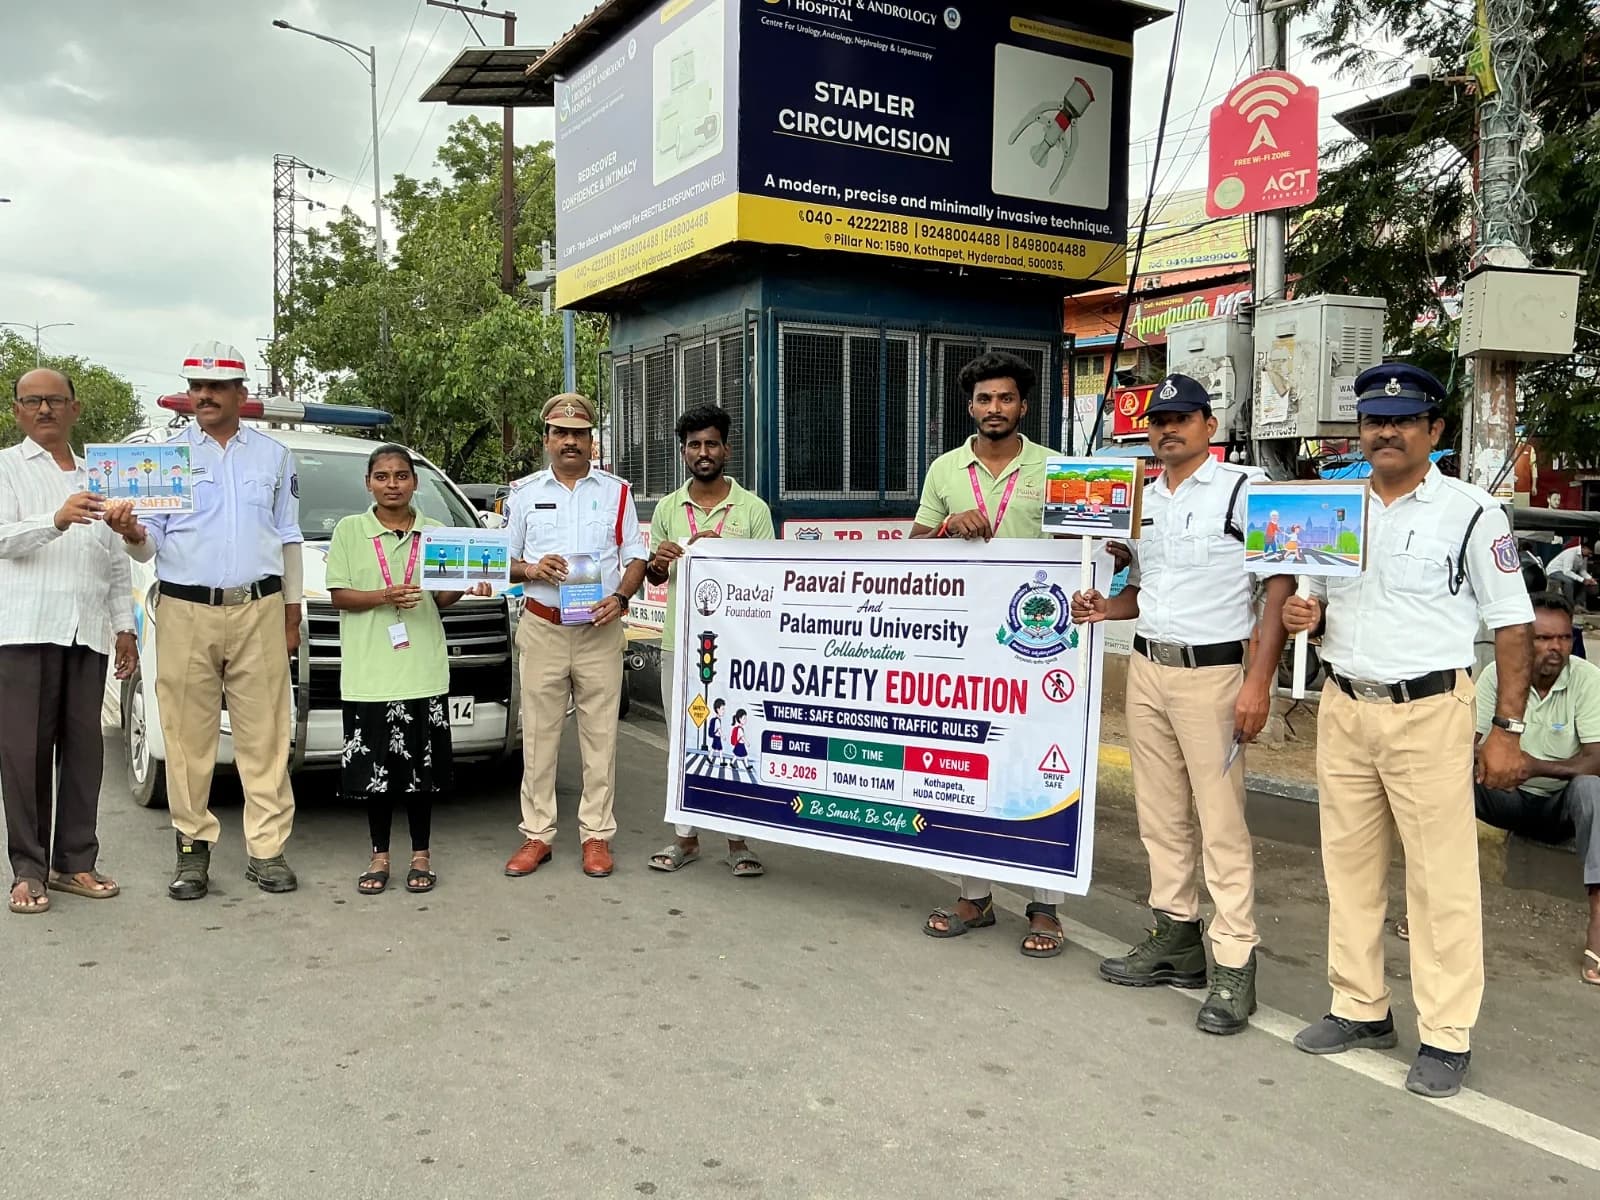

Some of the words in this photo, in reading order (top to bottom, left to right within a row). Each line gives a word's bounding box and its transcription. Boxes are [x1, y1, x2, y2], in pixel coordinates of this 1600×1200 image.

[796, 0, 853, 22] HOSPITAL
[867, 3, 938, 26] ANDROLOGY
[761, 16, 783, 29] Centre
[784, 21, 796, 31] For
[855, 36, 889, 52] Nephrology
[814, 81, 915, 119] STAPLER
[778, 109, 950, 157] CIRCUMCISION
[577, 151, 617, 184] REDISCOVER
[1234, 158, 1251, 167] FREE
[1271, 150, 1291, 160] ZONE
[562, 181, 599, 211] CONFIDENCE
[605, 158, 637, 187] INTIMACY
[1263, 169, 1311, 194] ACT
[640, 200, 667, 221] ERECTILE
[667, 178, 711, 208] DYSFUNCTION
[764, 174, 776, 188] A
[779, 177, 842, 199] modern,
[845, 187, 898, 208] precise
[901, 194, 927, 210] and
[930, 198, 994, 221] minimally
[997, 206, 1048, 226] invasive
[1051, 214, 1113, 236] technique.
[805, 209, 833, 225] 040
[847, 216, 909, 235] 42222188
[834, 233, 863, 248] Pillar
[865, 237, 883, 251] No:
[885, 240, 912, 256] 1590,
[914, 243, 966, 263] Kothapet,
[967, 250, 1026, 269] Hyderabad,
[1028, 257, 1066, 272] 500035.
[140, 497, 180, 508] SAFETY
[726, 584, 774, 602] Paavai
[783, 570, 846, 593] Paavai
[852, 571, 965, 597] Foundation
[725, 606, 771, 618] Foundation
[857, 599, 884, 613] And
[780, 612, 863, 637] Palamuru
[870, 617, 968, 648] University
[824, 639, 906, 661] Collaboration
[730, 659, 785, 693] ROAD
[792, 662, 879, 702] SAFETY
[885, 669, 1028, 715] EDUCATION
[809, 710, 834, 724] SAFE
[837, 712, 889, 729] CROSSING
[892, 717, 938, 734] TRAFFIC
[942, 721, 979, 738] RULES
[788, 741, 811, 753] DATE
[862, 749, 884, 762] TIME
[769, 762, 817, 780] 3_9_2026
[939, 758, 970, 772] VENUE
[832, 772, 857, 786] 10AM
[859, 775, 869, 788] to
[871, 777, 895, 791] 11AM
[1043, 772, 1065, 782] DRIVE
[1044, 780, 1063, 790] SAFE
[913, 789, 933, 800] HUDA
[935, 792, 976, 806] COMPLEXE
[809, 801, 824, 815] Be
[826, 803, 862, 823] Smart,
[865, 809, 881, 825] Be
[882, 811, 907, 829] Safe
